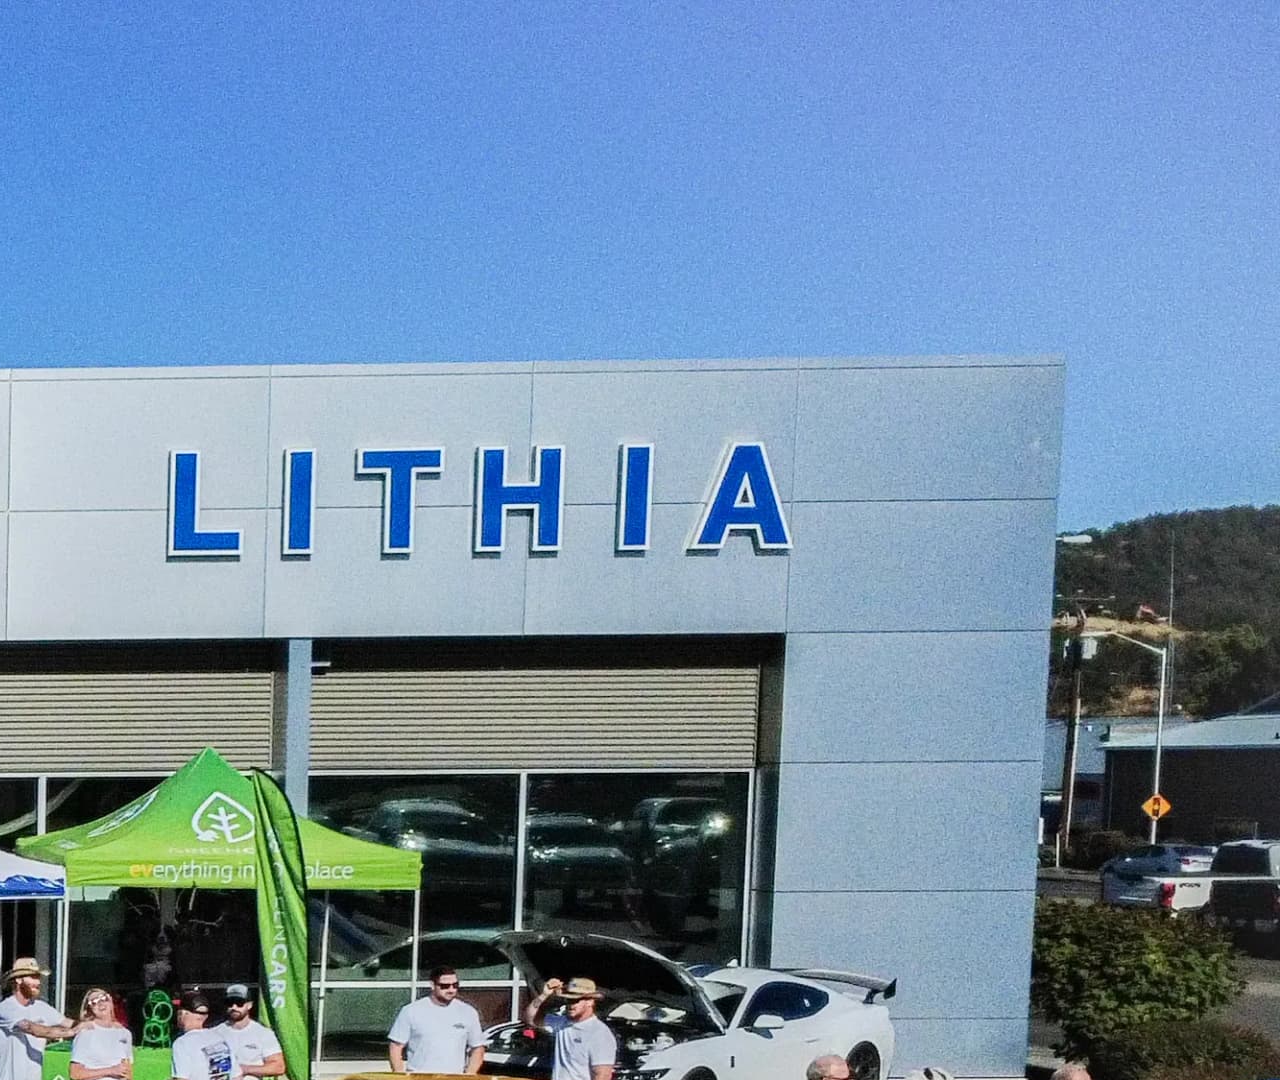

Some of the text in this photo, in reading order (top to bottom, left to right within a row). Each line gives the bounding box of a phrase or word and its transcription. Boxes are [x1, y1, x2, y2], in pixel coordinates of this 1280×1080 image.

[167, 442, 793, 558] LITHIA
[129, 860, 233, 884] everything
[238, 860, 256, 877] in
